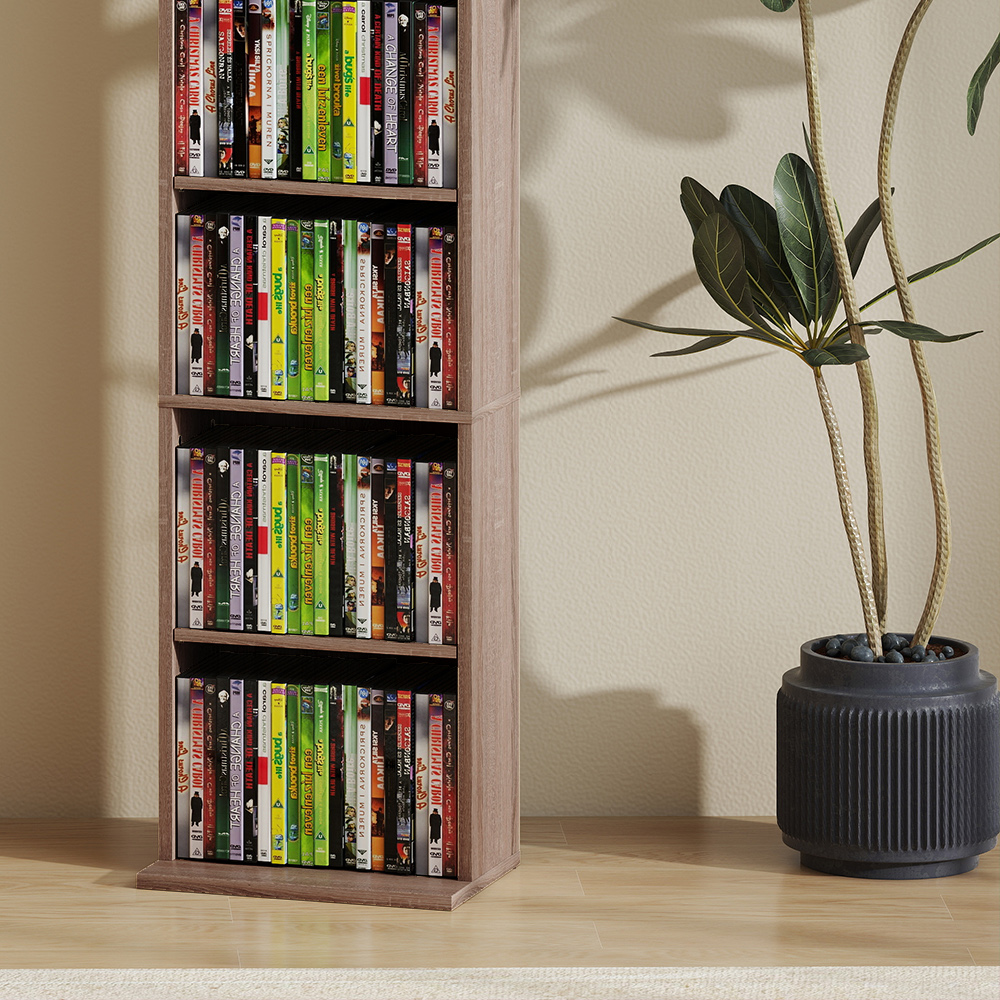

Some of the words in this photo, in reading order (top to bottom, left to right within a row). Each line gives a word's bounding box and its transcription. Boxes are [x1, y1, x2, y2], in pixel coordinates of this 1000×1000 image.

[387, 34, 394, 42] A
[189, 26, 200, 77] CHRISTMAS
[428, 35, 438, 87] CHRISTMAS
[205, 61, 216, 78] Line
[317, 64, 327, 86] een
[343, 56, 355, 83] bug's
[374, 69, 381, 81] OF
[385, 44, 396, 95] CHANGE
[445, 70, 455, 88] Line
[205, 79, 216, 104] Chorus
[333, 83, 342, 116] brouka
[344, 84, 352, 98] life
[444, 89, 455, 114] Chorus
[205, 105, 215, 113] A
[387, 97, 395, 111] OF
[317, 87, 330, 151] luizenleven
[444, 115, 455, 123] A
[385, 113, 396, 153] HEART
